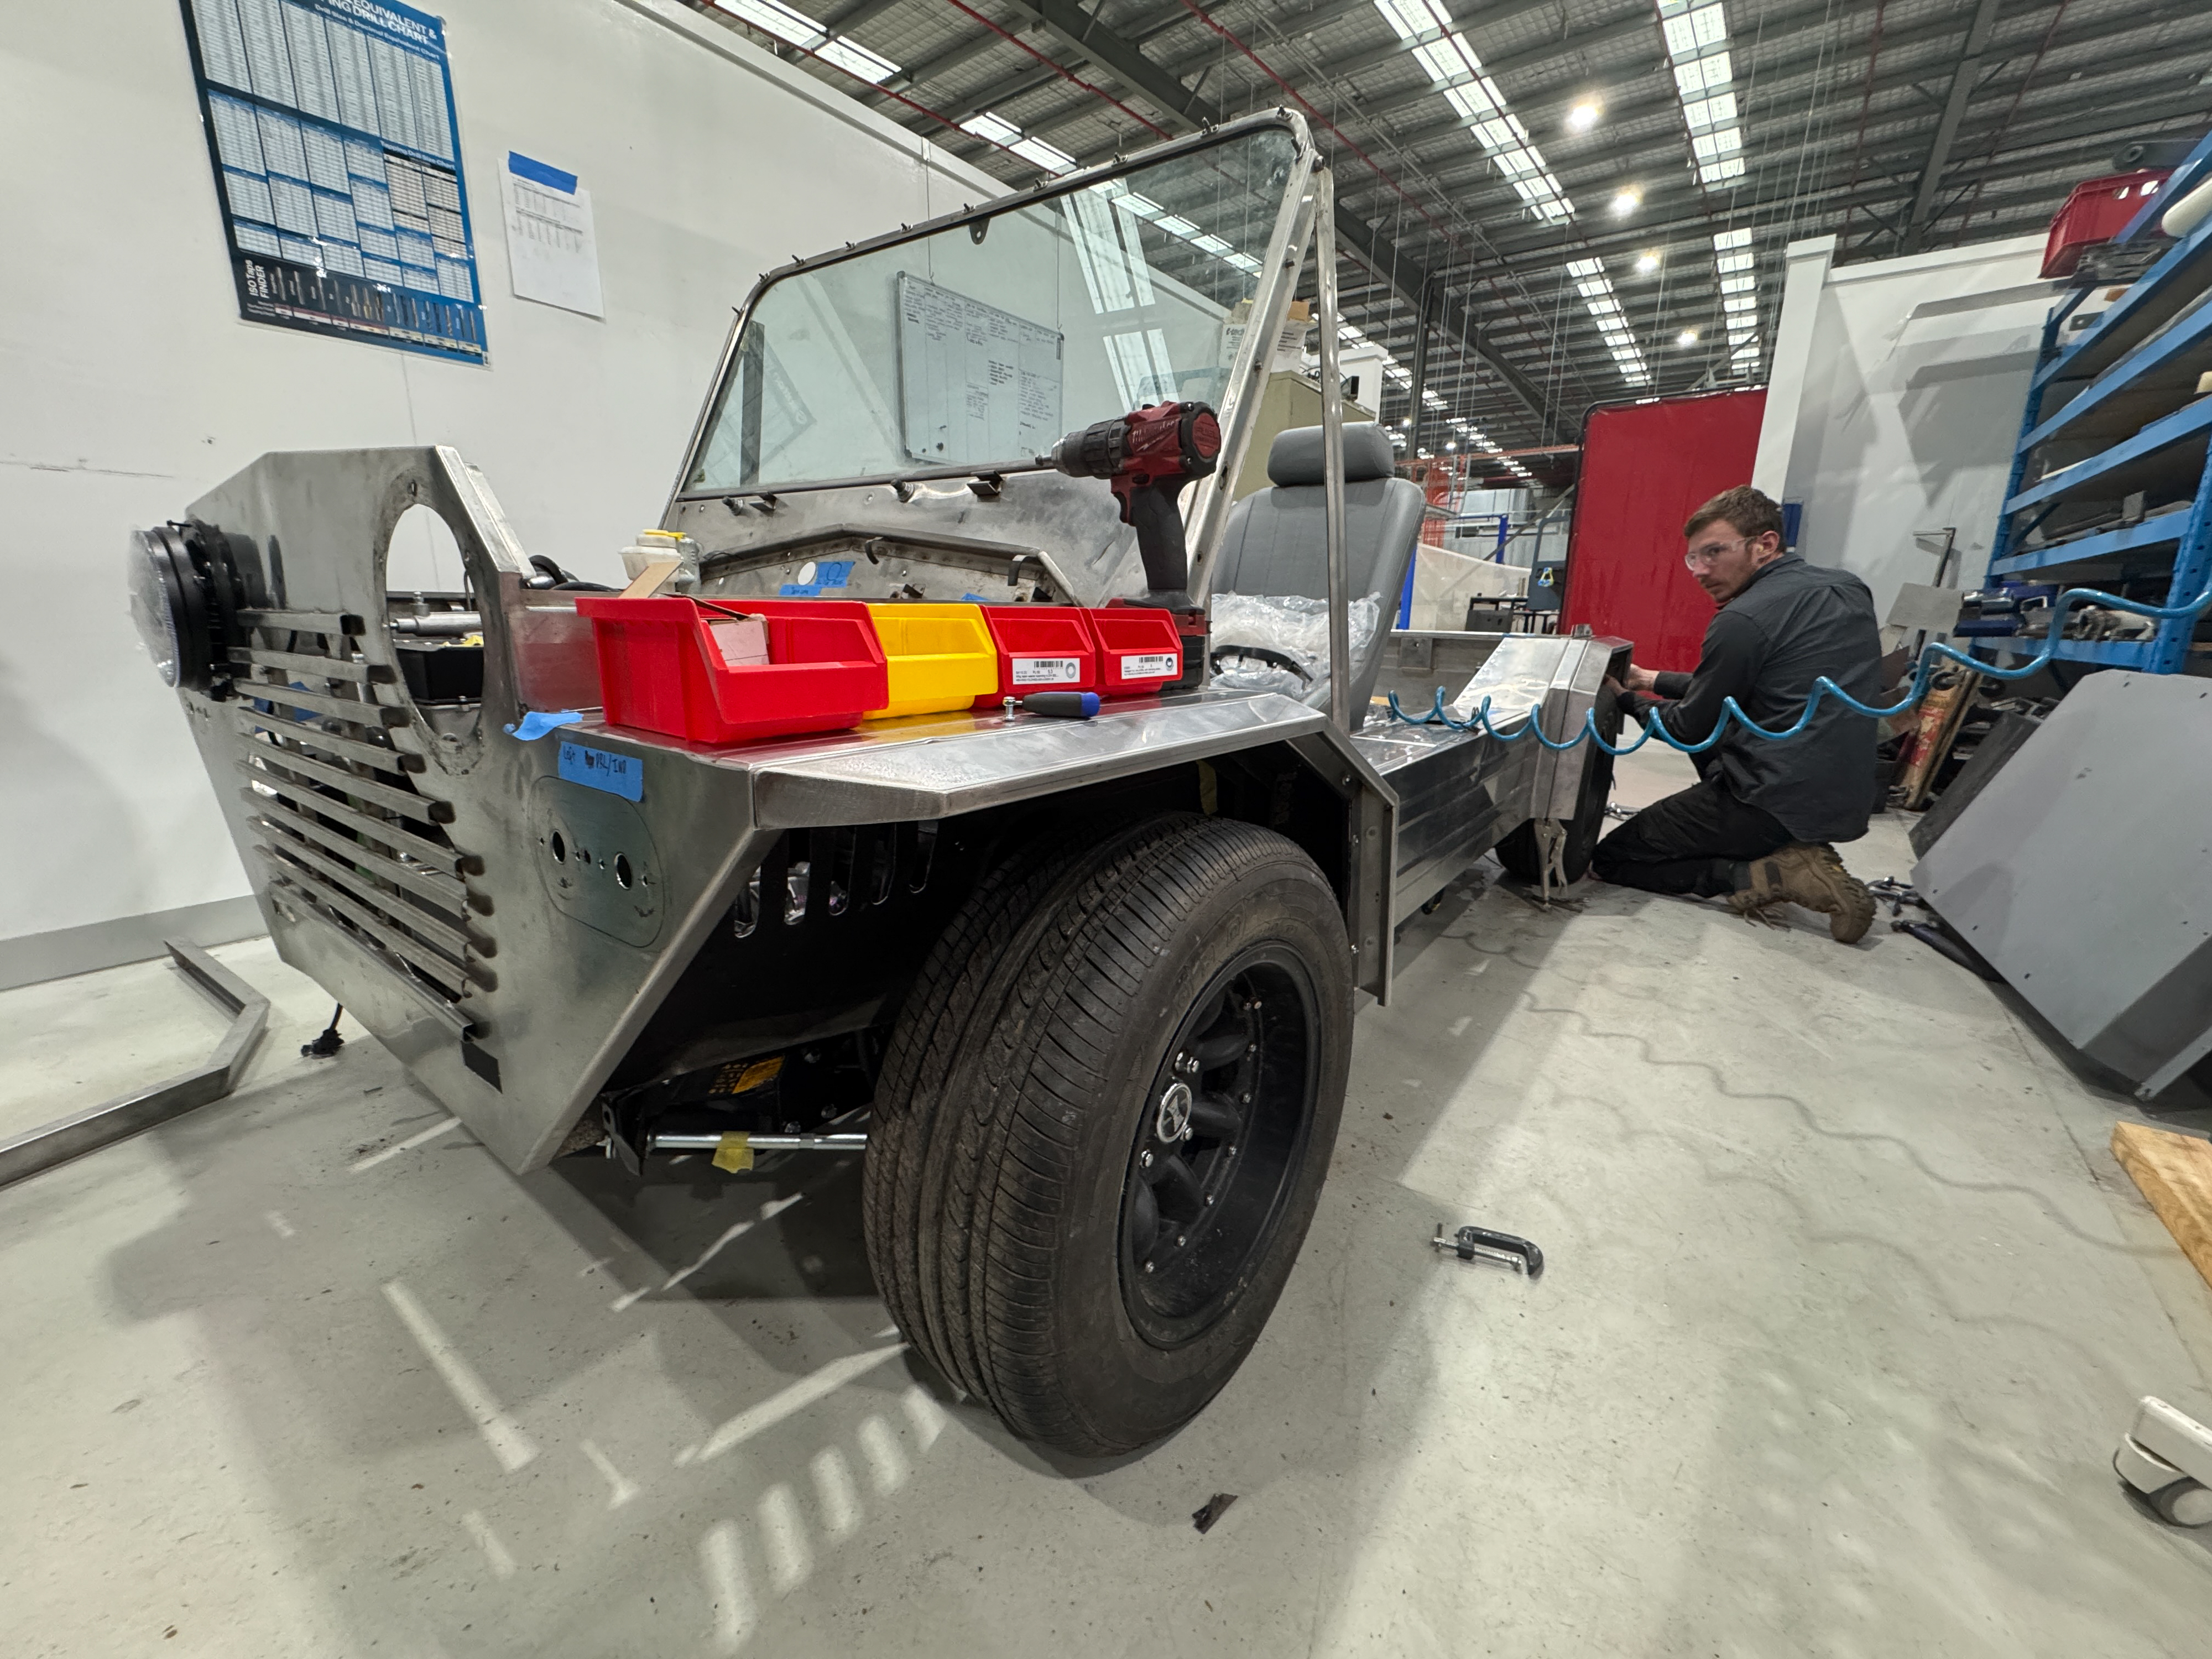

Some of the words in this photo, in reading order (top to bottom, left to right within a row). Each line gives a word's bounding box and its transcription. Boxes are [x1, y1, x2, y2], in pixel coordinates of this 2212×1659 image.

[353, 0, 426, 34] EQUIVALENT
[429, 29, 437, 40] &
[353, 4, 387, 28] DRILL
[388, 21, 429, 44] CHART
[245, 259, 255, 278] Taps
[254, 265, 270, 299] FINDER
[247, 279, 259, 297] ISO
